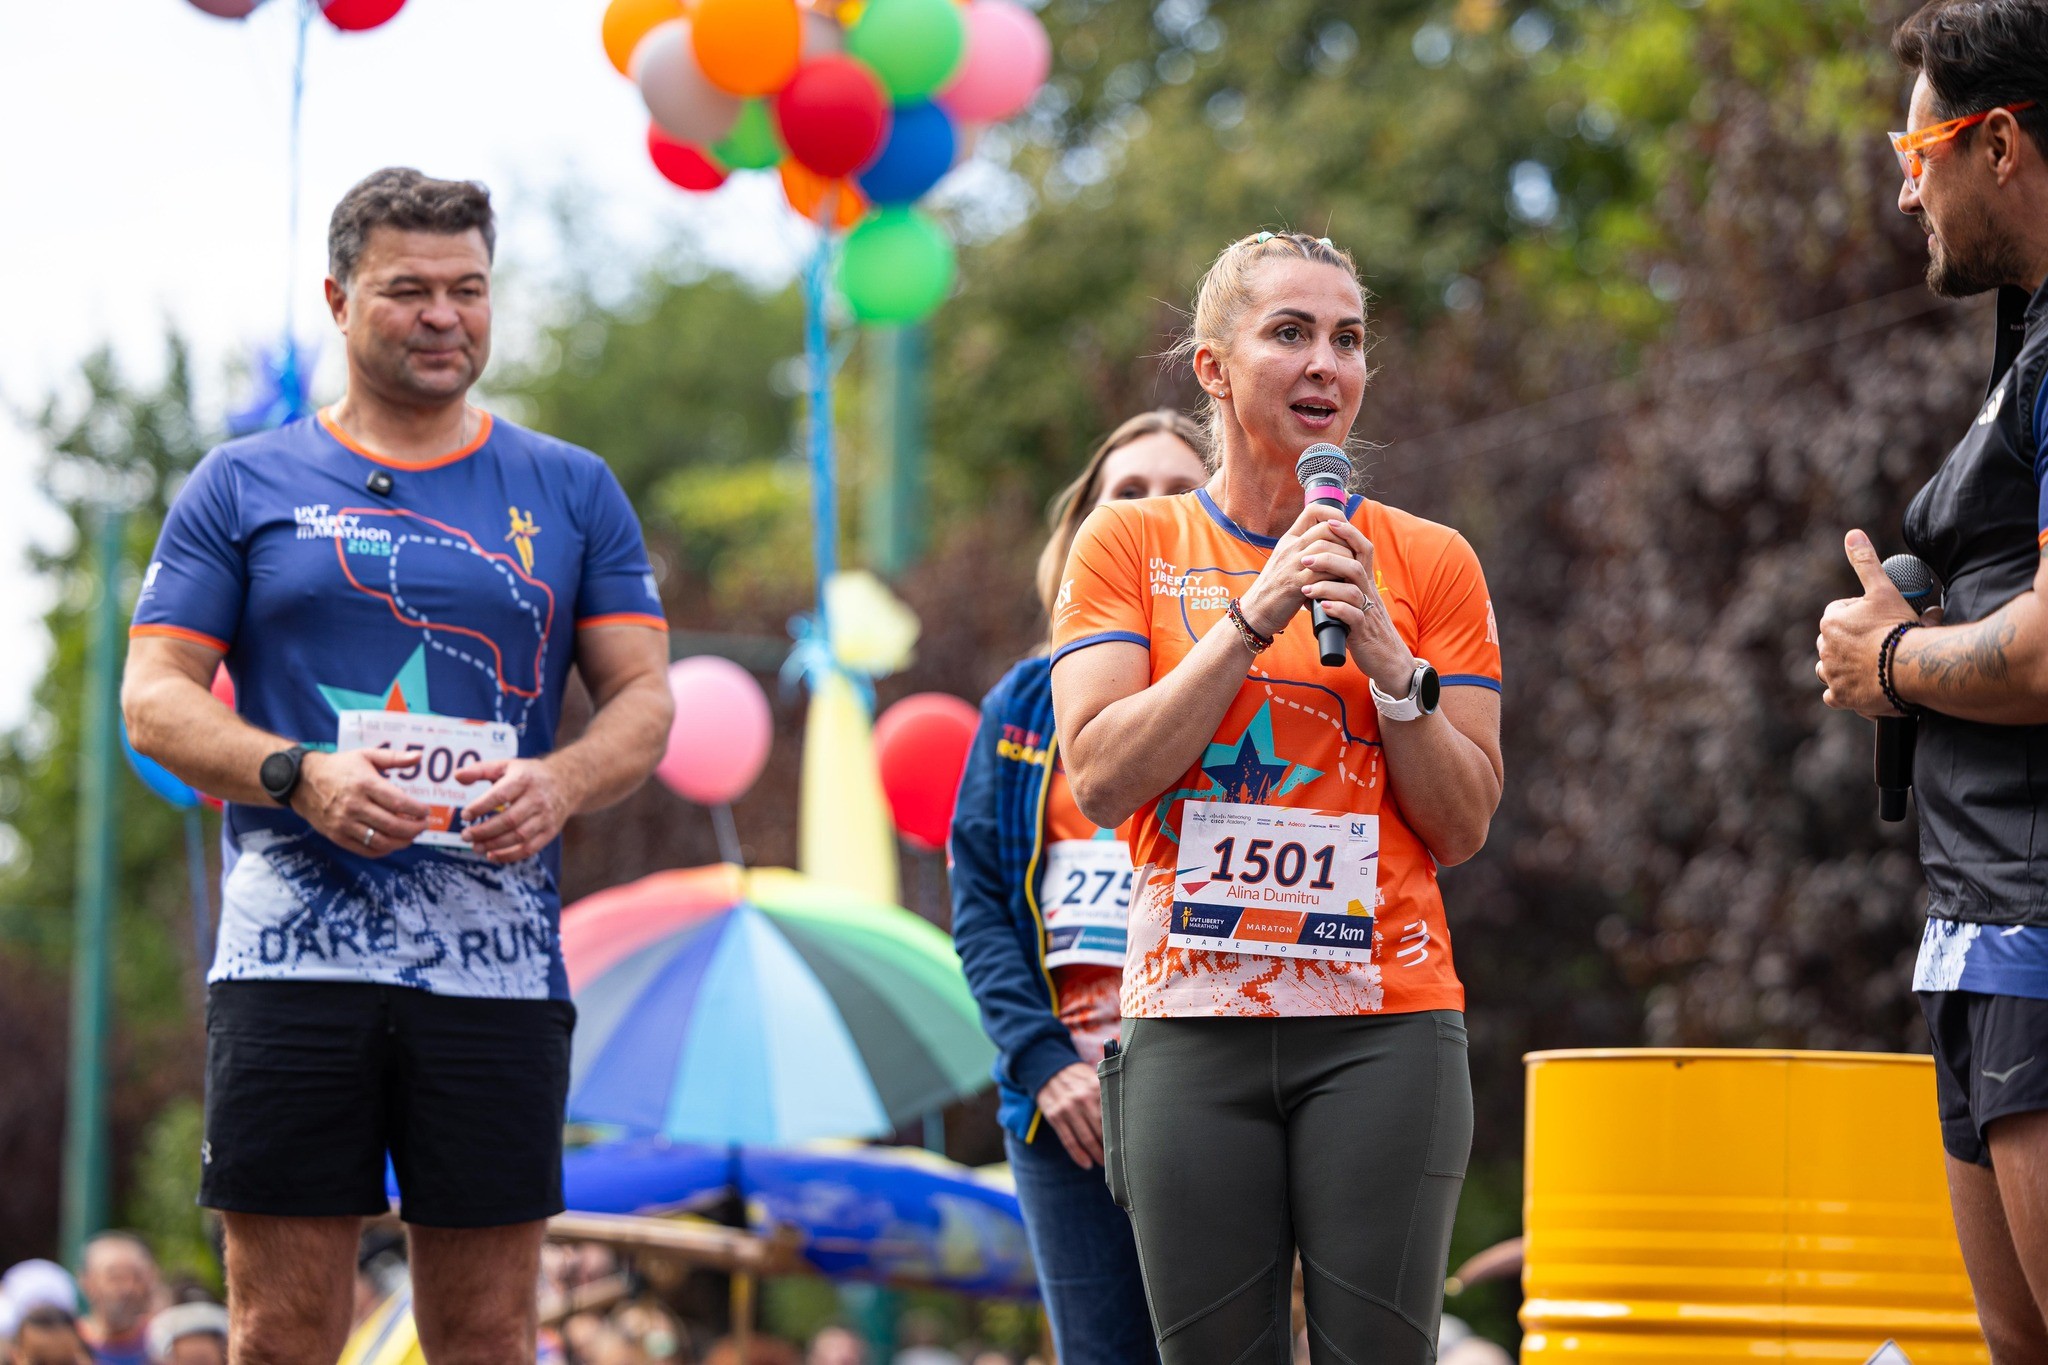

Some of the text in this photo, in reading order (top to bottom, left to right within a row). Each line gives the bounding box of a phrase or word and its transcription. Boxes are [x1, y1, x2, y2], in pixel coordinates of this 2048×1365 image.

[294, 504, 330, 523] UVT
[296, 514, 360, 528] LIBERTY
[347, 538, 391, 556] 2025
[1149, 557, 1177, 575] UVT
[1149, 570, 1204, 587] LIBERTY
[1190, 597, 1231, 610] 2025
[1209, 836, 1336, 891] 1501
[1226, 885, 1320, 905] Alina Dumitru
[1189, 922, 1219, 930] MARATHON
[1246, 923, 1293, 934] MARATON
[1313, 921, 1365, 941] 42 km
[1186, 937, 1351, 958] DARE TO RUN
